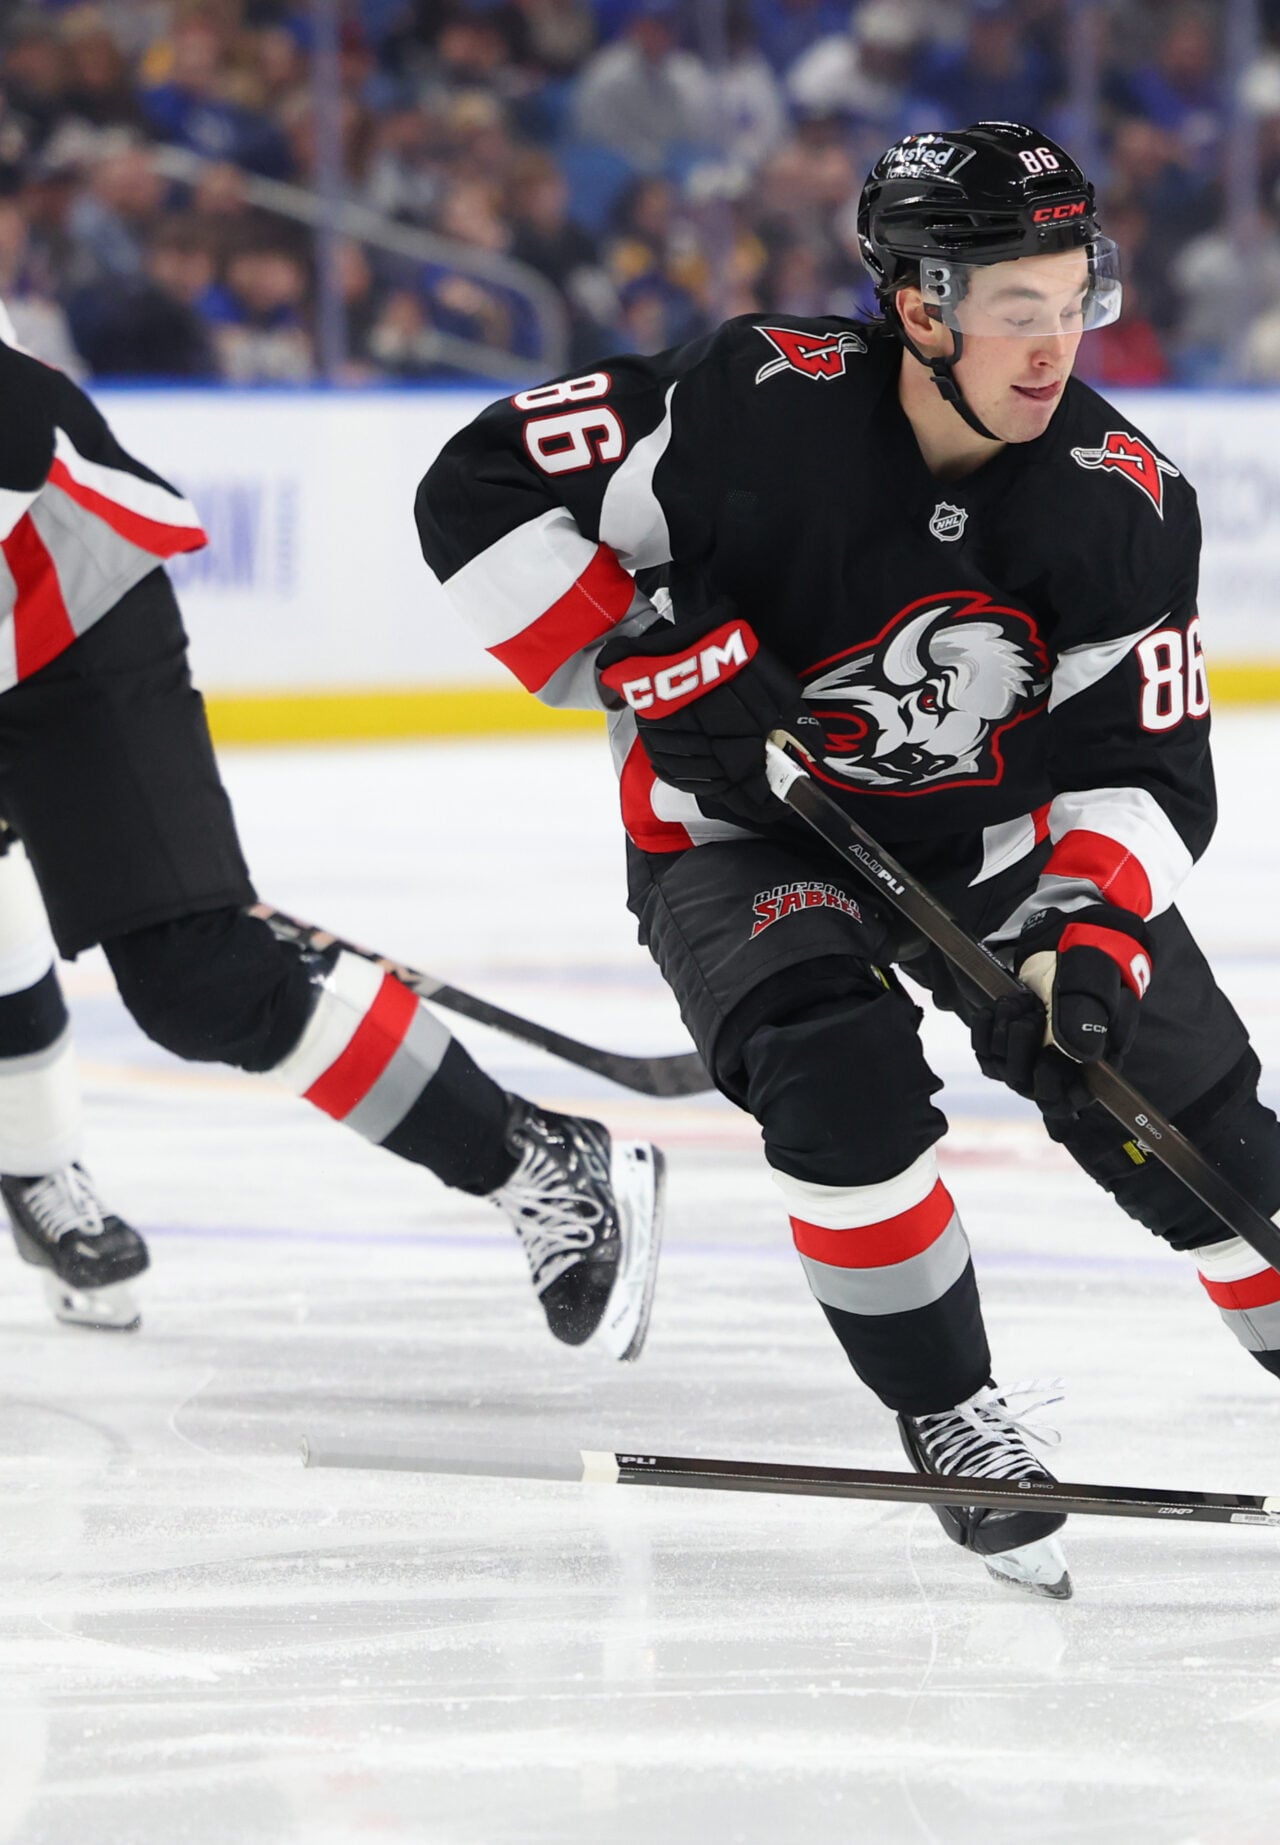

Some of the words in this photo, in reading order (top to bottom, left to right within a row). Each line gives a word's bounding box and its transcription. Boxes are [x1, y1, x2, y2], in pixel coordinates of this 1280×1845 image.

[882, 145, 955, 166] Trusted
[1018, 147, 1060, 174] 86
[1033, 200, 1086, 223] CCM
[511, 371, 627, 478] 86
[935, 515, 961, 531] NHL
[621, 628, 749, 711] CCM
[1135, 614, 1211, 734] 86
[848, 843, 905, 896] ALUPLI
[1134, 1113, 1149, 1127] 8
[1145, 1123, 1162, 1140] PRO
[617, 1456, 657, 1465] PLI
[1018, 1481, 1031, 1489] 8
